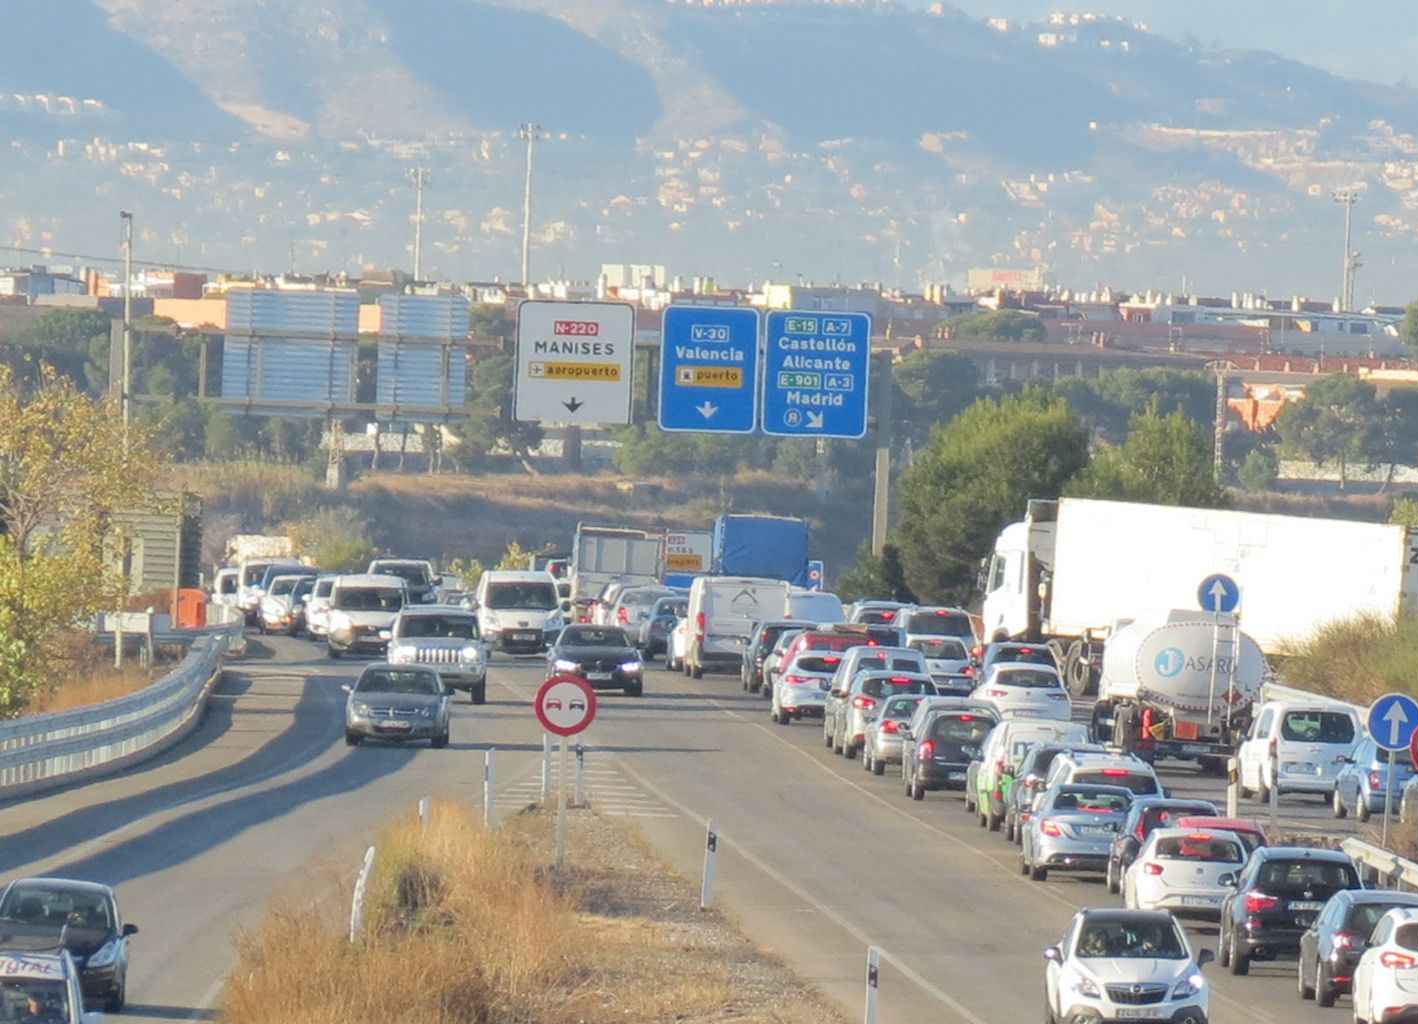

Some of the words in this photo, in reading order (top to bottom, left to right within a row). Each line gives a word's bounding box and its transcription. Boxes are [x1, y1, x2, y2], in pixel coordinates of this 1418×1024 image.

[555, 322, 598, 334] N-220
[694, 327, 727, 340] V-30
[788, 320, 815, 331] E-15
[826, 322, 849, 333] A-7
[534, 341, 615, 356] MANISES
[778, 336, 857, 352] Castellón
[675, 345, 745, 361] Valencia
[782, 355, 851, 370] Alicante
[546, 367, 619, 378] aeropuerto
[696, 370, 739, 381] puerto
[780, 374, 819, 387] E-901
[827, 377, 851, 389] A-3
[786, 390, 843, 406] Madrid
